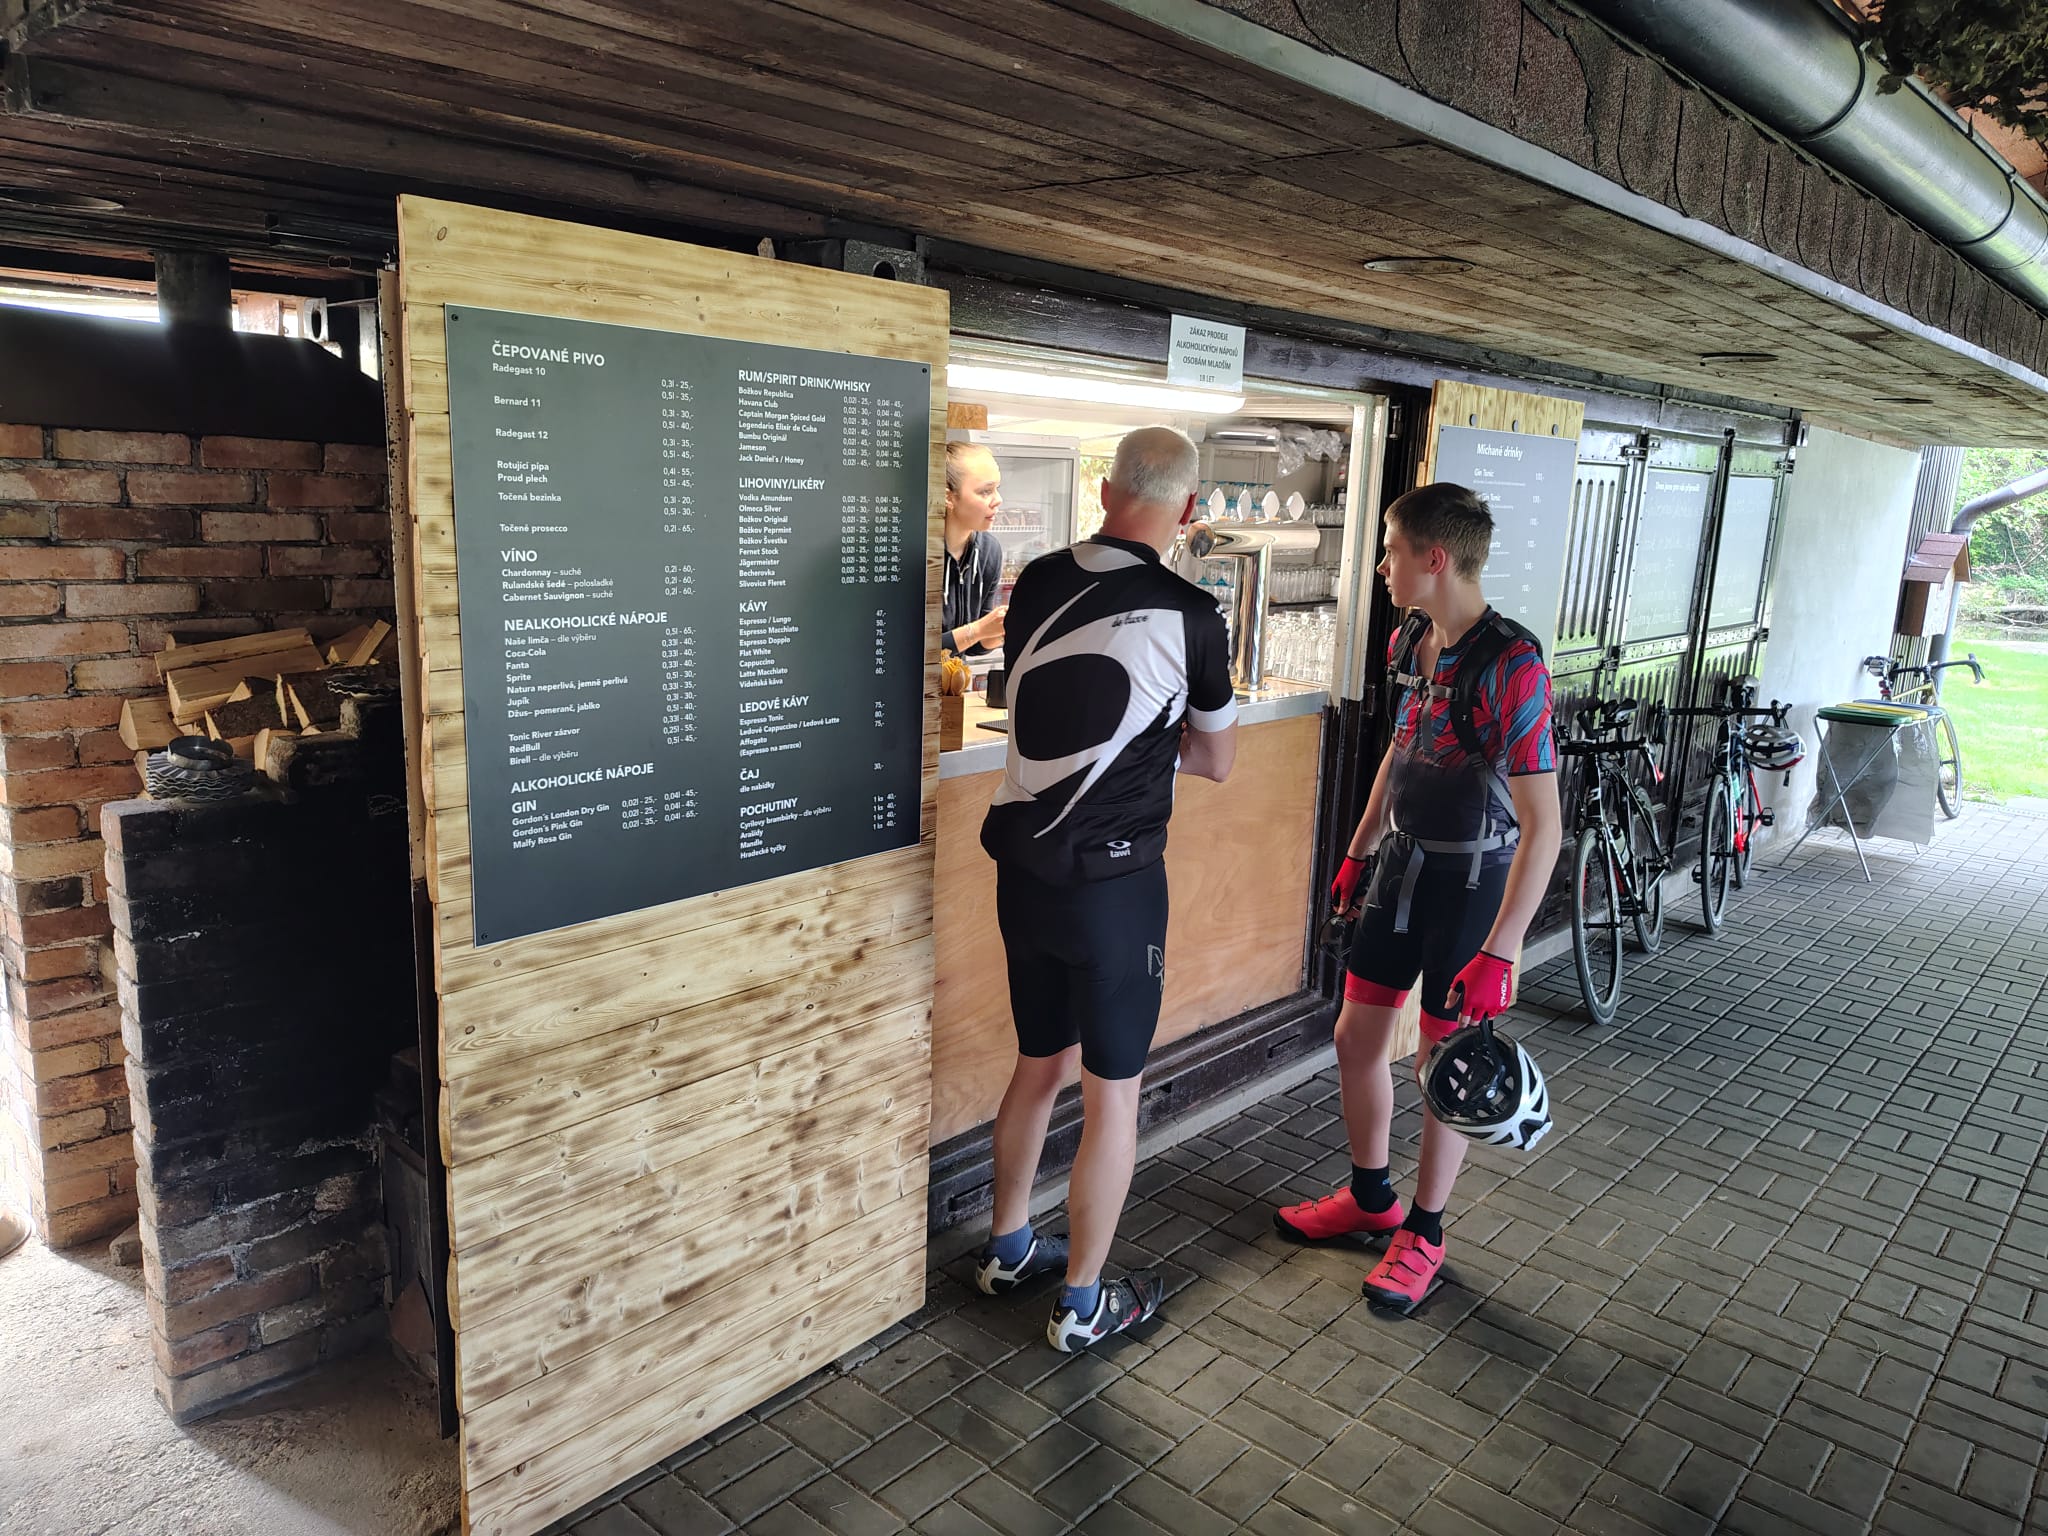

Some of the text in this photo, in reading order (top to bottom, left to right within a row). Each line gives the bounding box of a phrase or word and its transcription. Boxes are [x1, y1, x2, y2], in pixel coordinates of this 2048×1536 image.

[1189, 326, 1229, 341] ZÁKAZ PRODEJE
[492, 340, 604, 366] ČEPOVANÉ PIVO
[1176, 340, 1218, 354] ALKOHOLICKÝCH
[1183, 355, 1231, 370] OSOBÁM MLADŠÍM
[492, 363, 545, 376] Radegast 10
[738, 369, 870, 392] RUM/SPIRIT DRINK/WHISKY
[1206, 375, 1215, 383] LET
[494, 395, 540, 407] Bernard 11
[496, 428, 548, 440] Radegast 12
[1503, 445, 1523, 461] drinky
[497, 473, 548, 484] Proud plech
[739, 477, 825, 490] LIHOVINY/LIKÉRY
[498, 492, 561, 501] Točená bezinka
[500, 547, 537, 562] VÍNO
[502, 567, 582, 578] Chardonnay suché
[502, 580, 545, 589] Rulandské
[503, 590, 613, 602] Cabernet Sauvignon suché
[740, 599, 767, 612] KÁVY
[504, 611, 667, 631] NEALKOHOLICKÉ NÁPOJE
[505, 637, 526, 645] Naše
[557, 634, 569, 642] dle
[571, 633, 596, 643] výběru
[505, 648, 546, 658] Coca-Cola
[506, 662, 529, 670] Fanta
[506, 673, 532, 683] Sprite
[507, 686, 535, 694] Natura
[602, 676, 628, 687] perlivá
[577, 702, 600, 713] jablko
[740, 695, 809, 713] LEDOVÉ KÁVY
[508, 728, 580, 741] Tonic River zázvor
[509, 742, 540, 753] RedBull
[509, 750, 578, 765] Birell dle výběru
[511, 763, 654, 793] ALKOHOLICKÉ NÁPOJE
[740, 768, 759, 780] ČAJ
[512, 800, 536, 813] GIN
[550, 809, 579, 819] London
[581, 807, 595, 815] Dry
[596, 803, 609, 811] Gin
[740, 797, 797, 817] POCHUTINY
[551, 821, 568, 831] Pink
[569, 819, 583, 827] Gin
[513, 832, 572, 849] Malfy Rosa Gin
